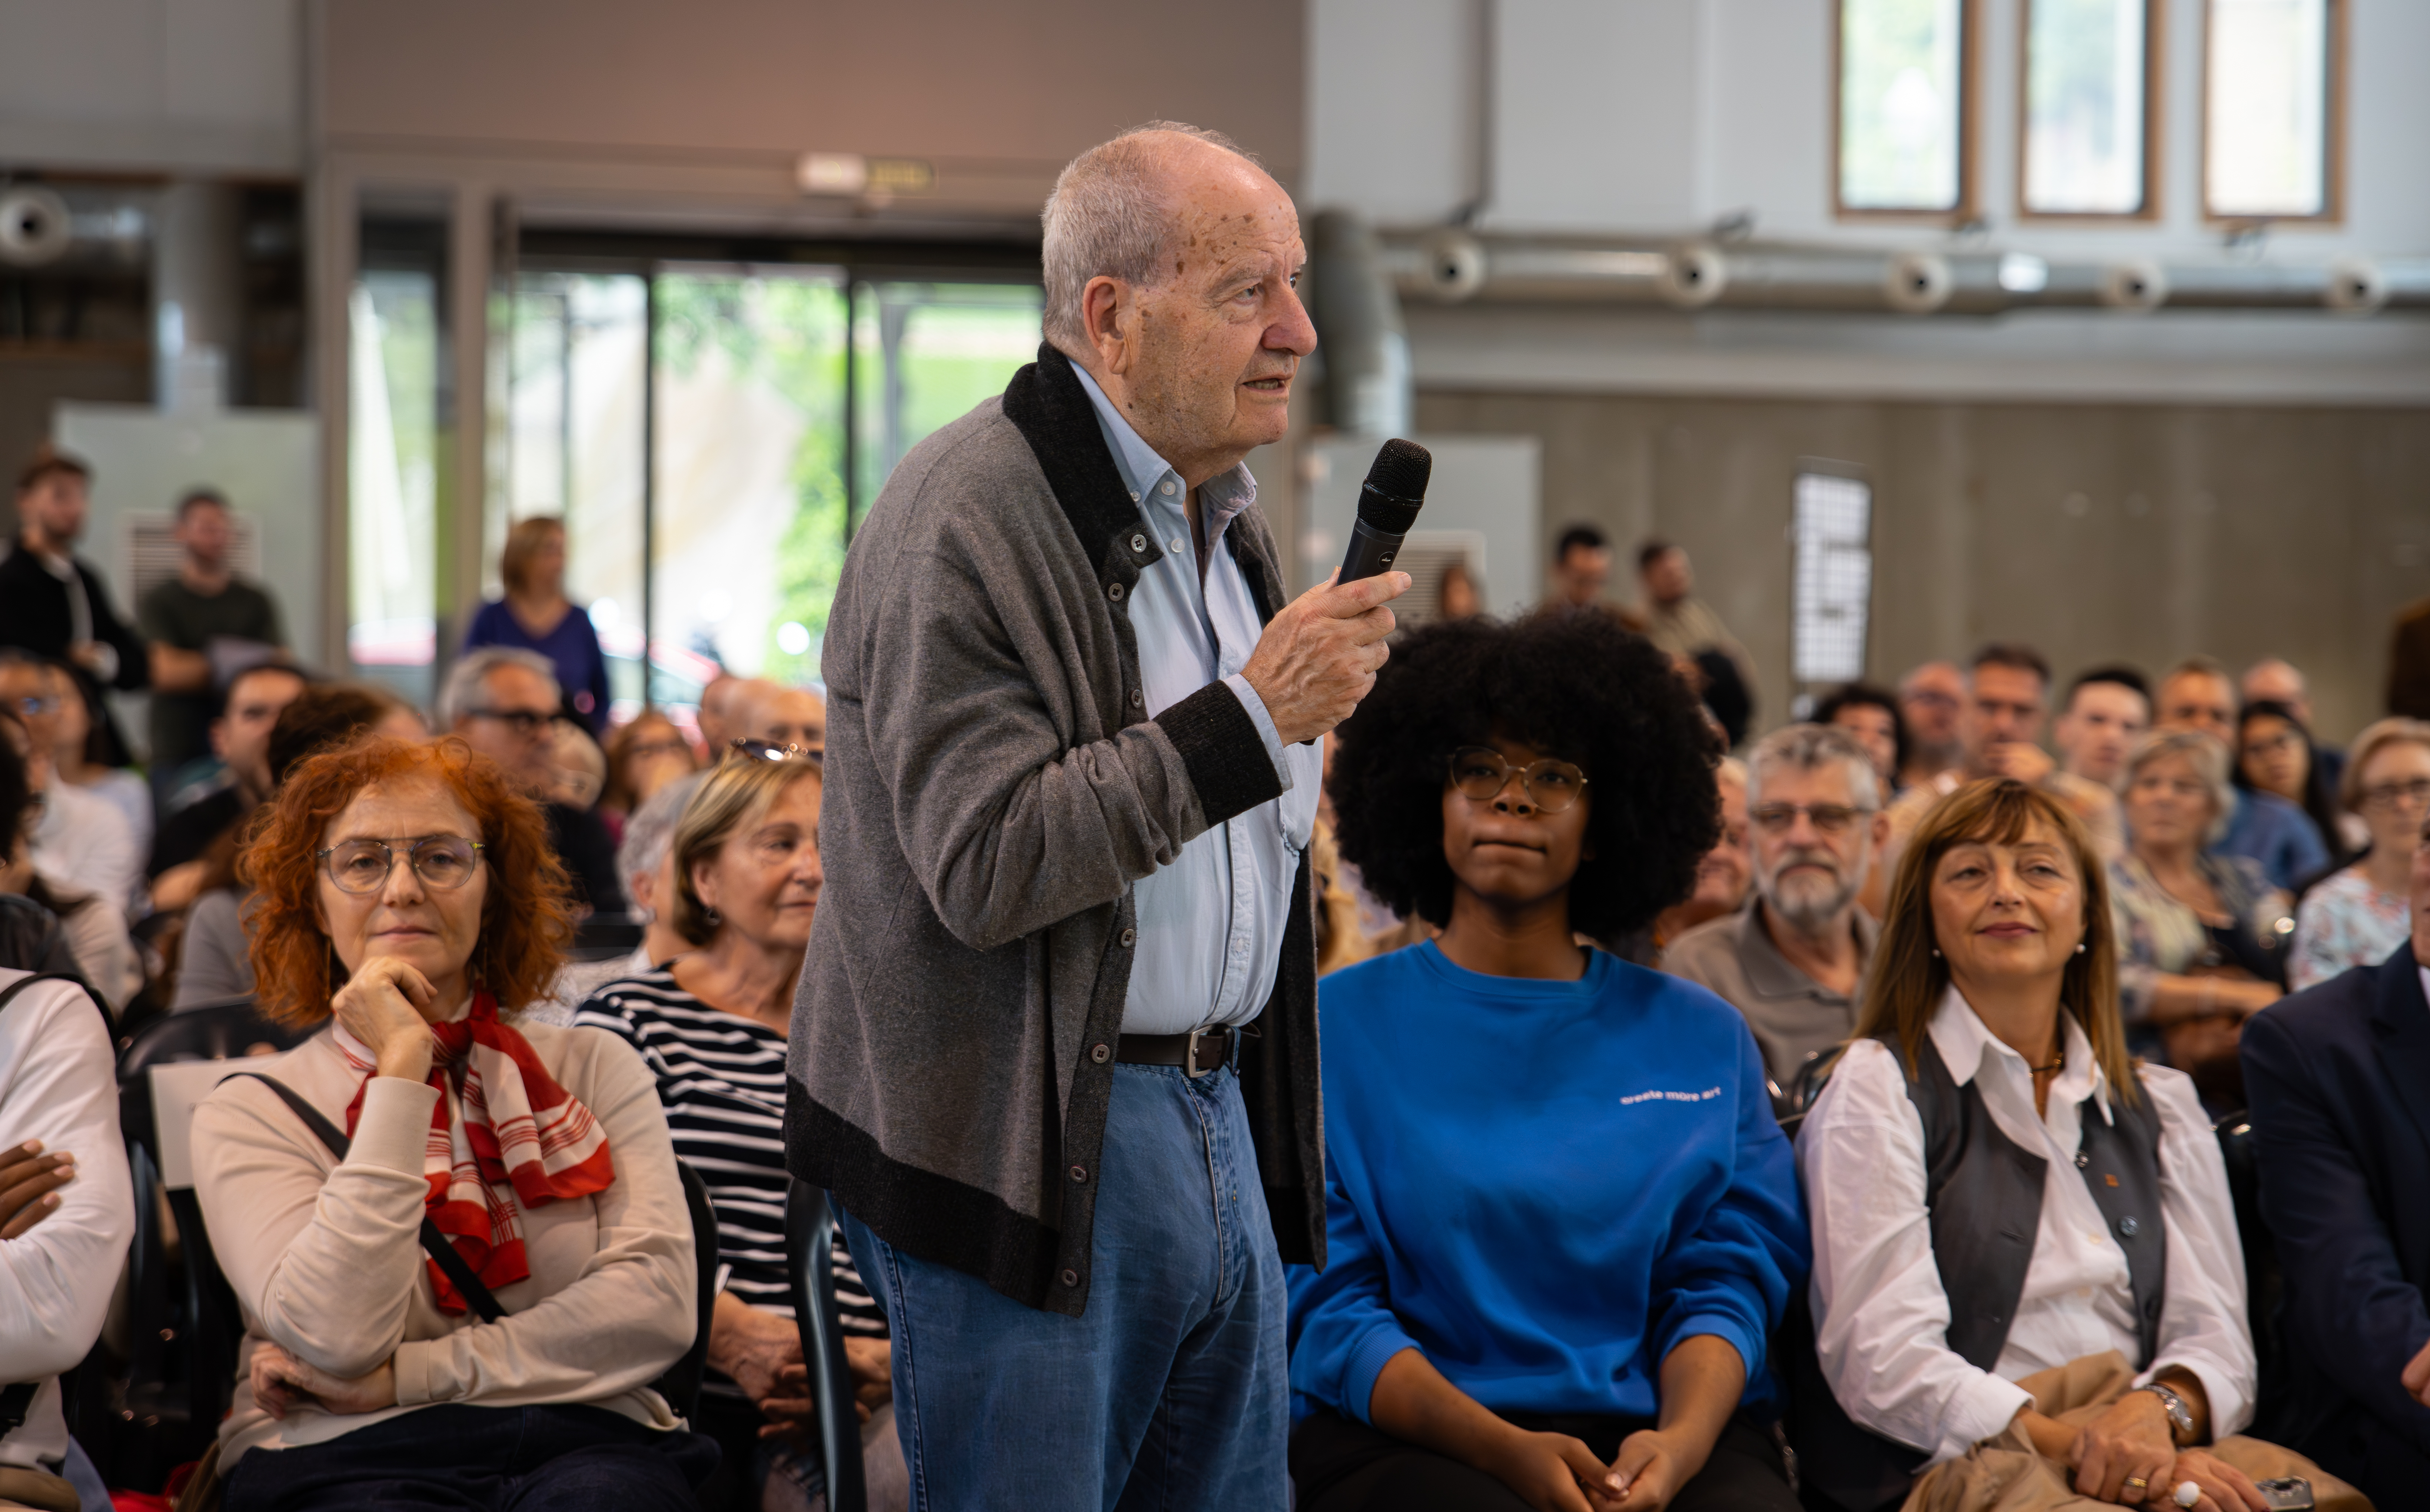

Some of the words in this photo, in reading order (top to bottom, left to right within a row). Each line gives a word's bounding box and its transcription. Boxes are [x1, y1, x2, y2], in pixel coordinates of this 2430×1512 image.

[1620, 1090, 1663, 1105] create
[1665, 1091, 1700, 1102] more
[1701, 1086, 1721, 1100] art
